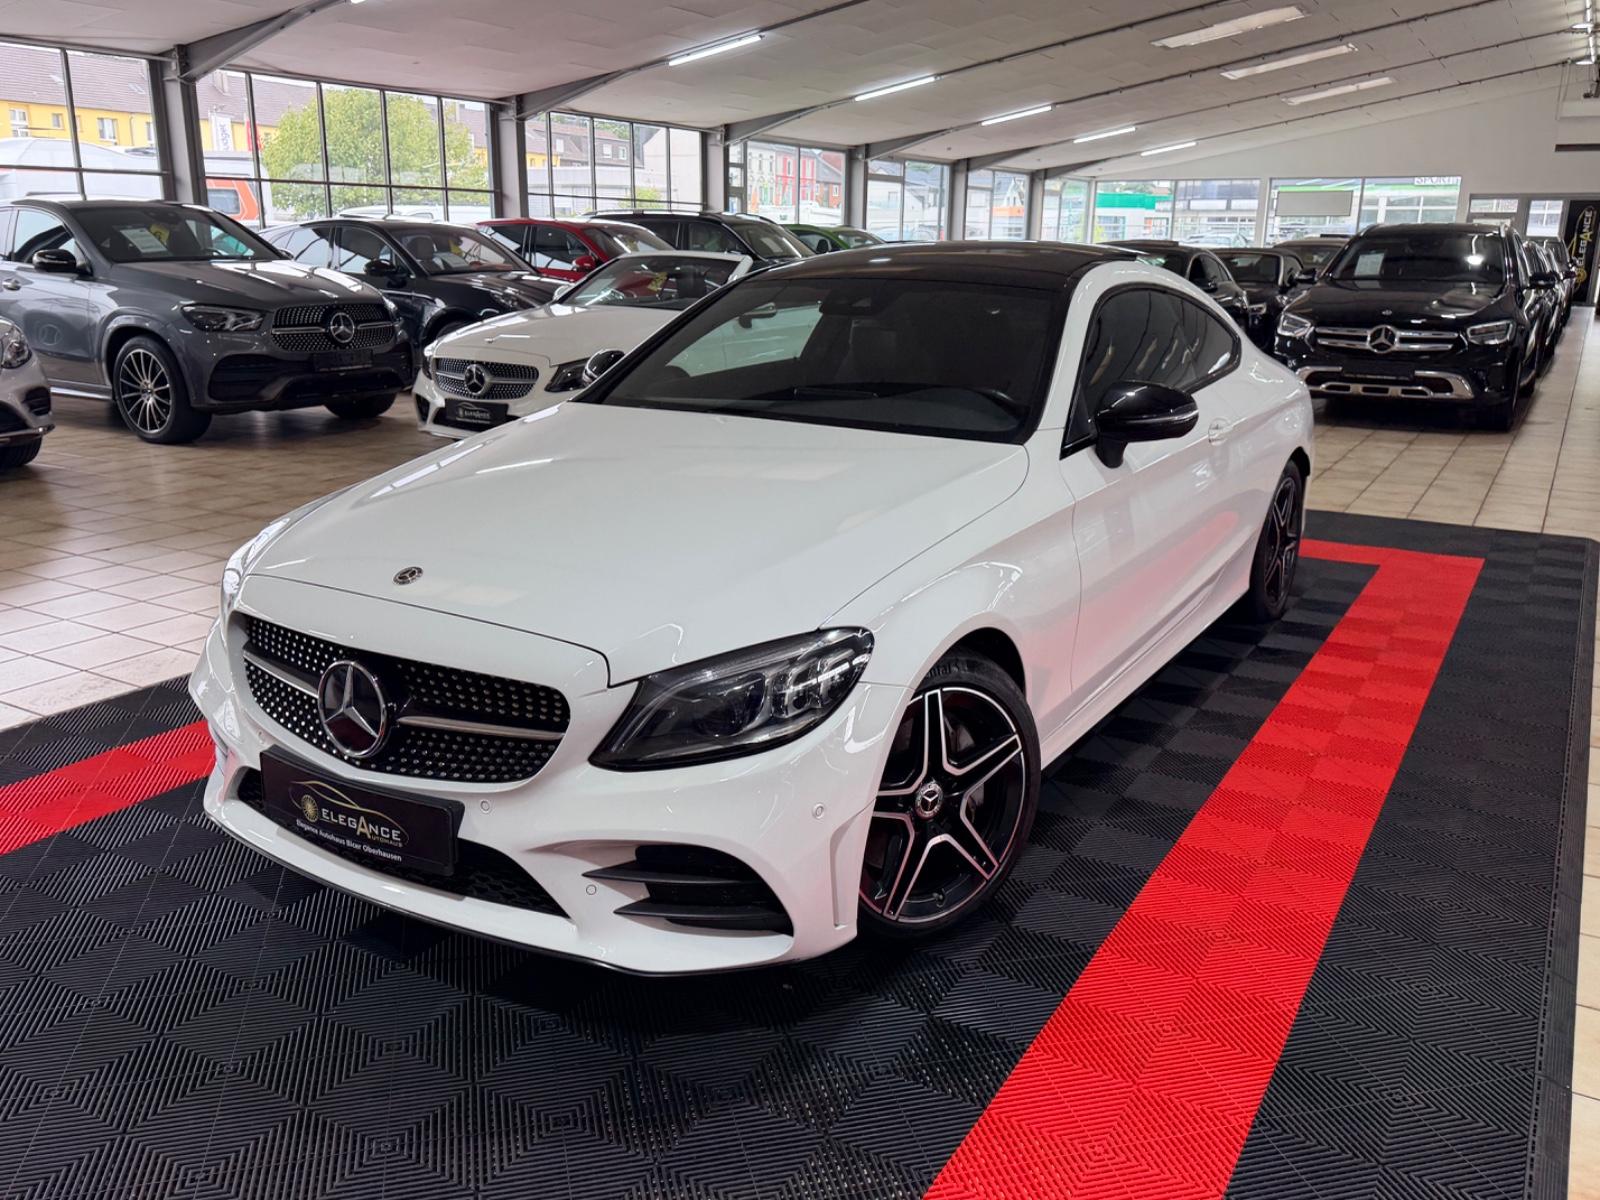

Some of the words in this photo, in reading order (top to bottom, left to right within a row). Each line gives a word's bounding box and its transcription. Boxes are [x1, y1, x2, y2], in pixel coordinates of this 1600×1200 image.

[1577, 210, 1593, 266] ELEGANCE
[296, 818, 318, 835] Elegance
[319, 829, 346, 846] Autohaus
[362, 844, 402, 862] Oberhausen
[321, 807, 401, 841] ELEGANCE
